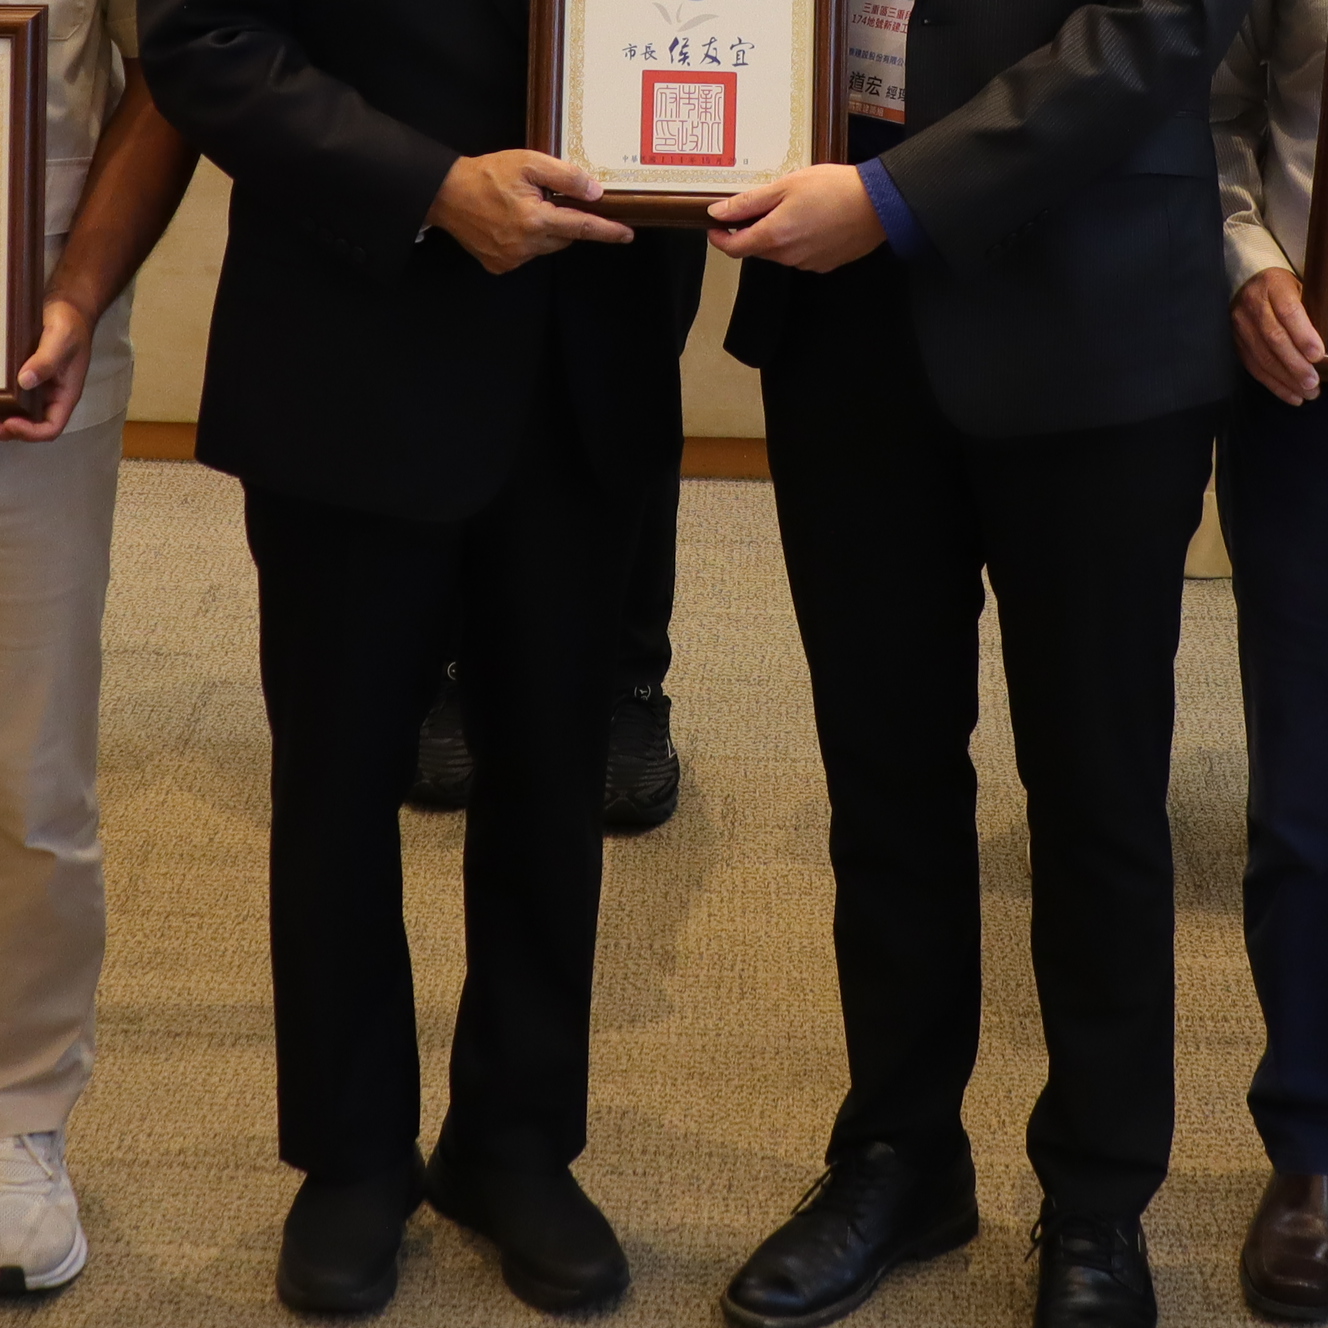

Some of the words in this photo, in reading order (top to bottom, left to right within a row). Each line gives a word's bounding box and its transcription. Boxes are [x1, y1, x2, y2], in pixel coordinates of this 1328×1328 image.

[622, 43, 658, 61] 市長
[668, 36, 755, 68] 侯友宜
[848, 71, 883, 97] 道宏
